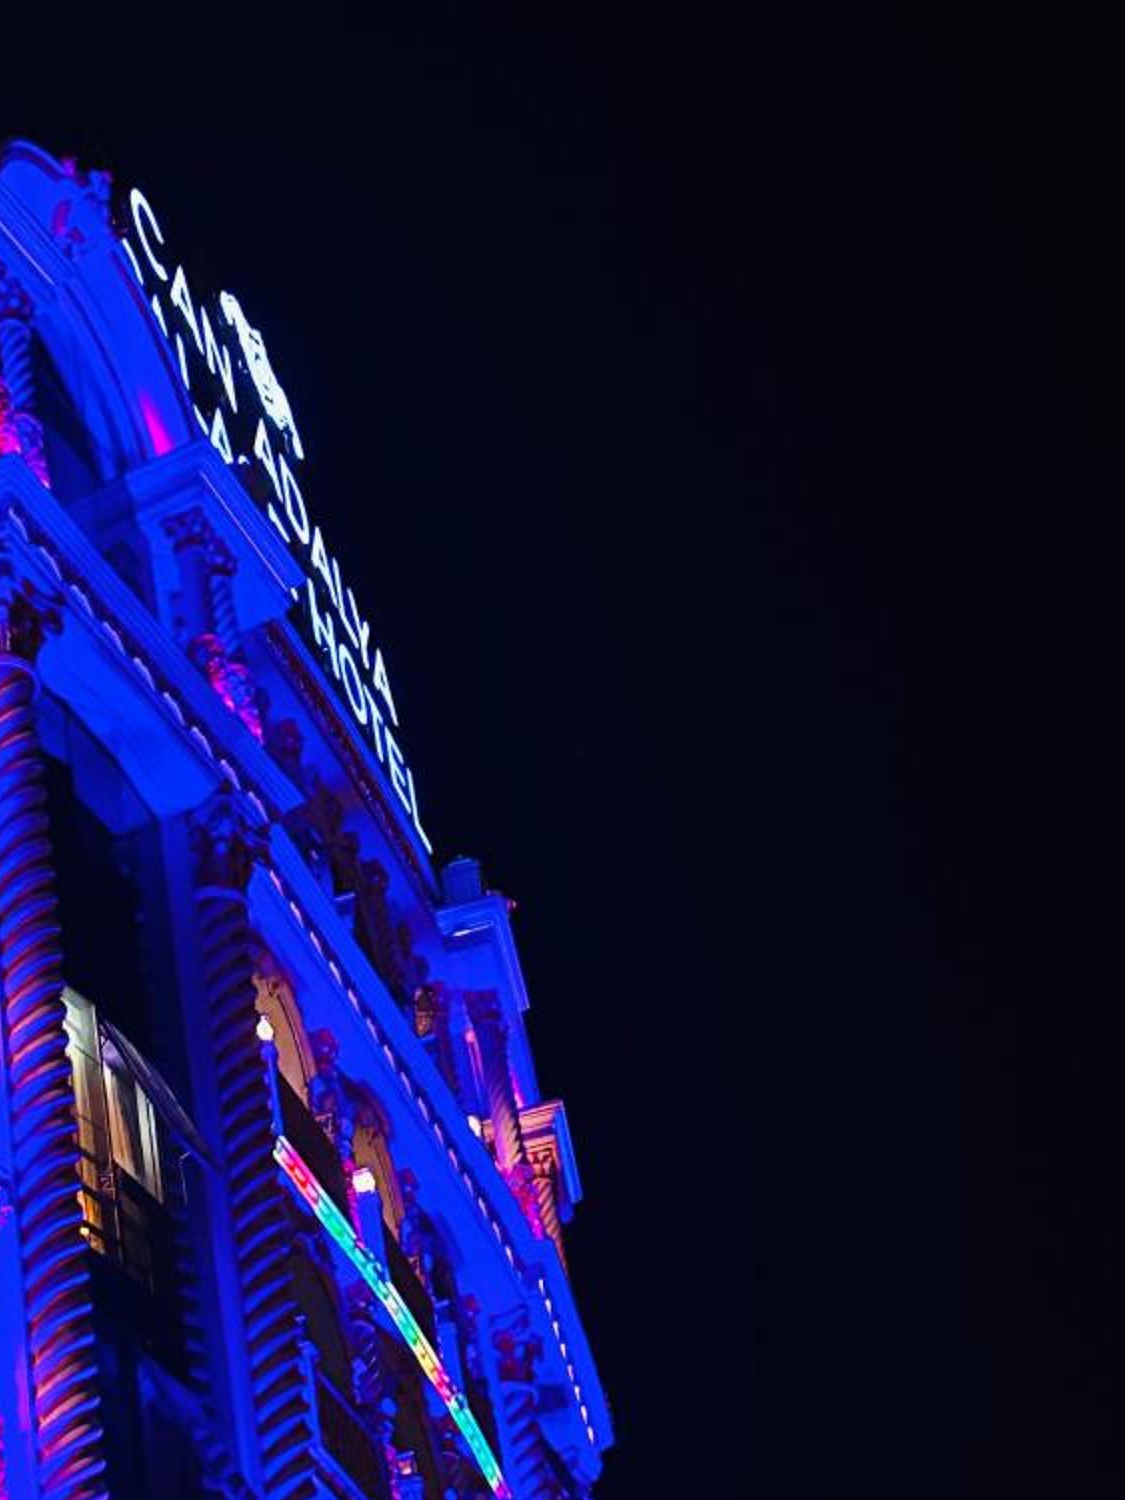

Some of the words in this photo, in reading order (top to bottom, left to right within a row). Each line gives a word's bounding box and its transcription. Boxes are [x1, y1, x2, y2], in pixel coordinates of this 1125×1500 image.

[130, 188, 237, 412] CAN
[253, 418, 399, 726] ADALYA
[307, 578, 432, 853] HOTEL
